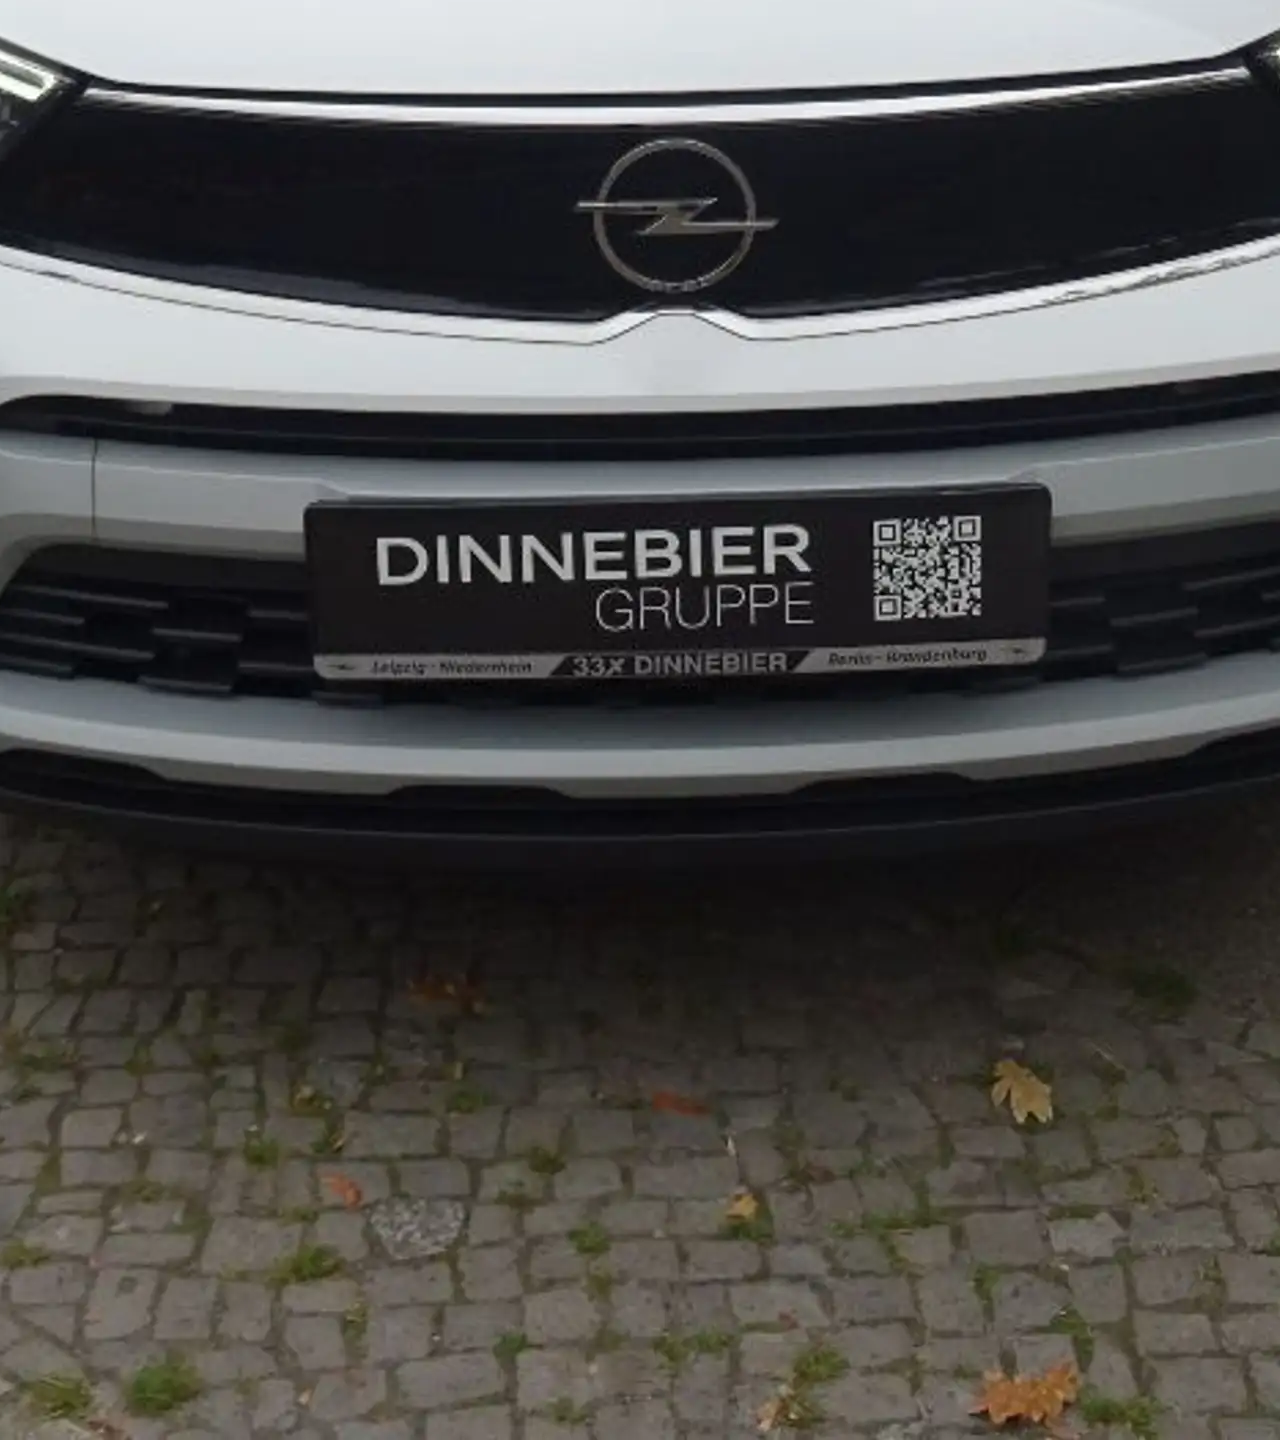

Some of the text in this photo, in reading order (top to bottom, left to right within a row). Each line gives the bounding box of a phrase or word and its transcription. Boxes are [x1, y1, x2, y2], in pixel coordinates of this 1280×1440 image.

[376, 524, 813, 587] DINNEBIER
[595, 581, 815, 632] GRUPPE
[634, 652, 788, 675] DINNEBIER
